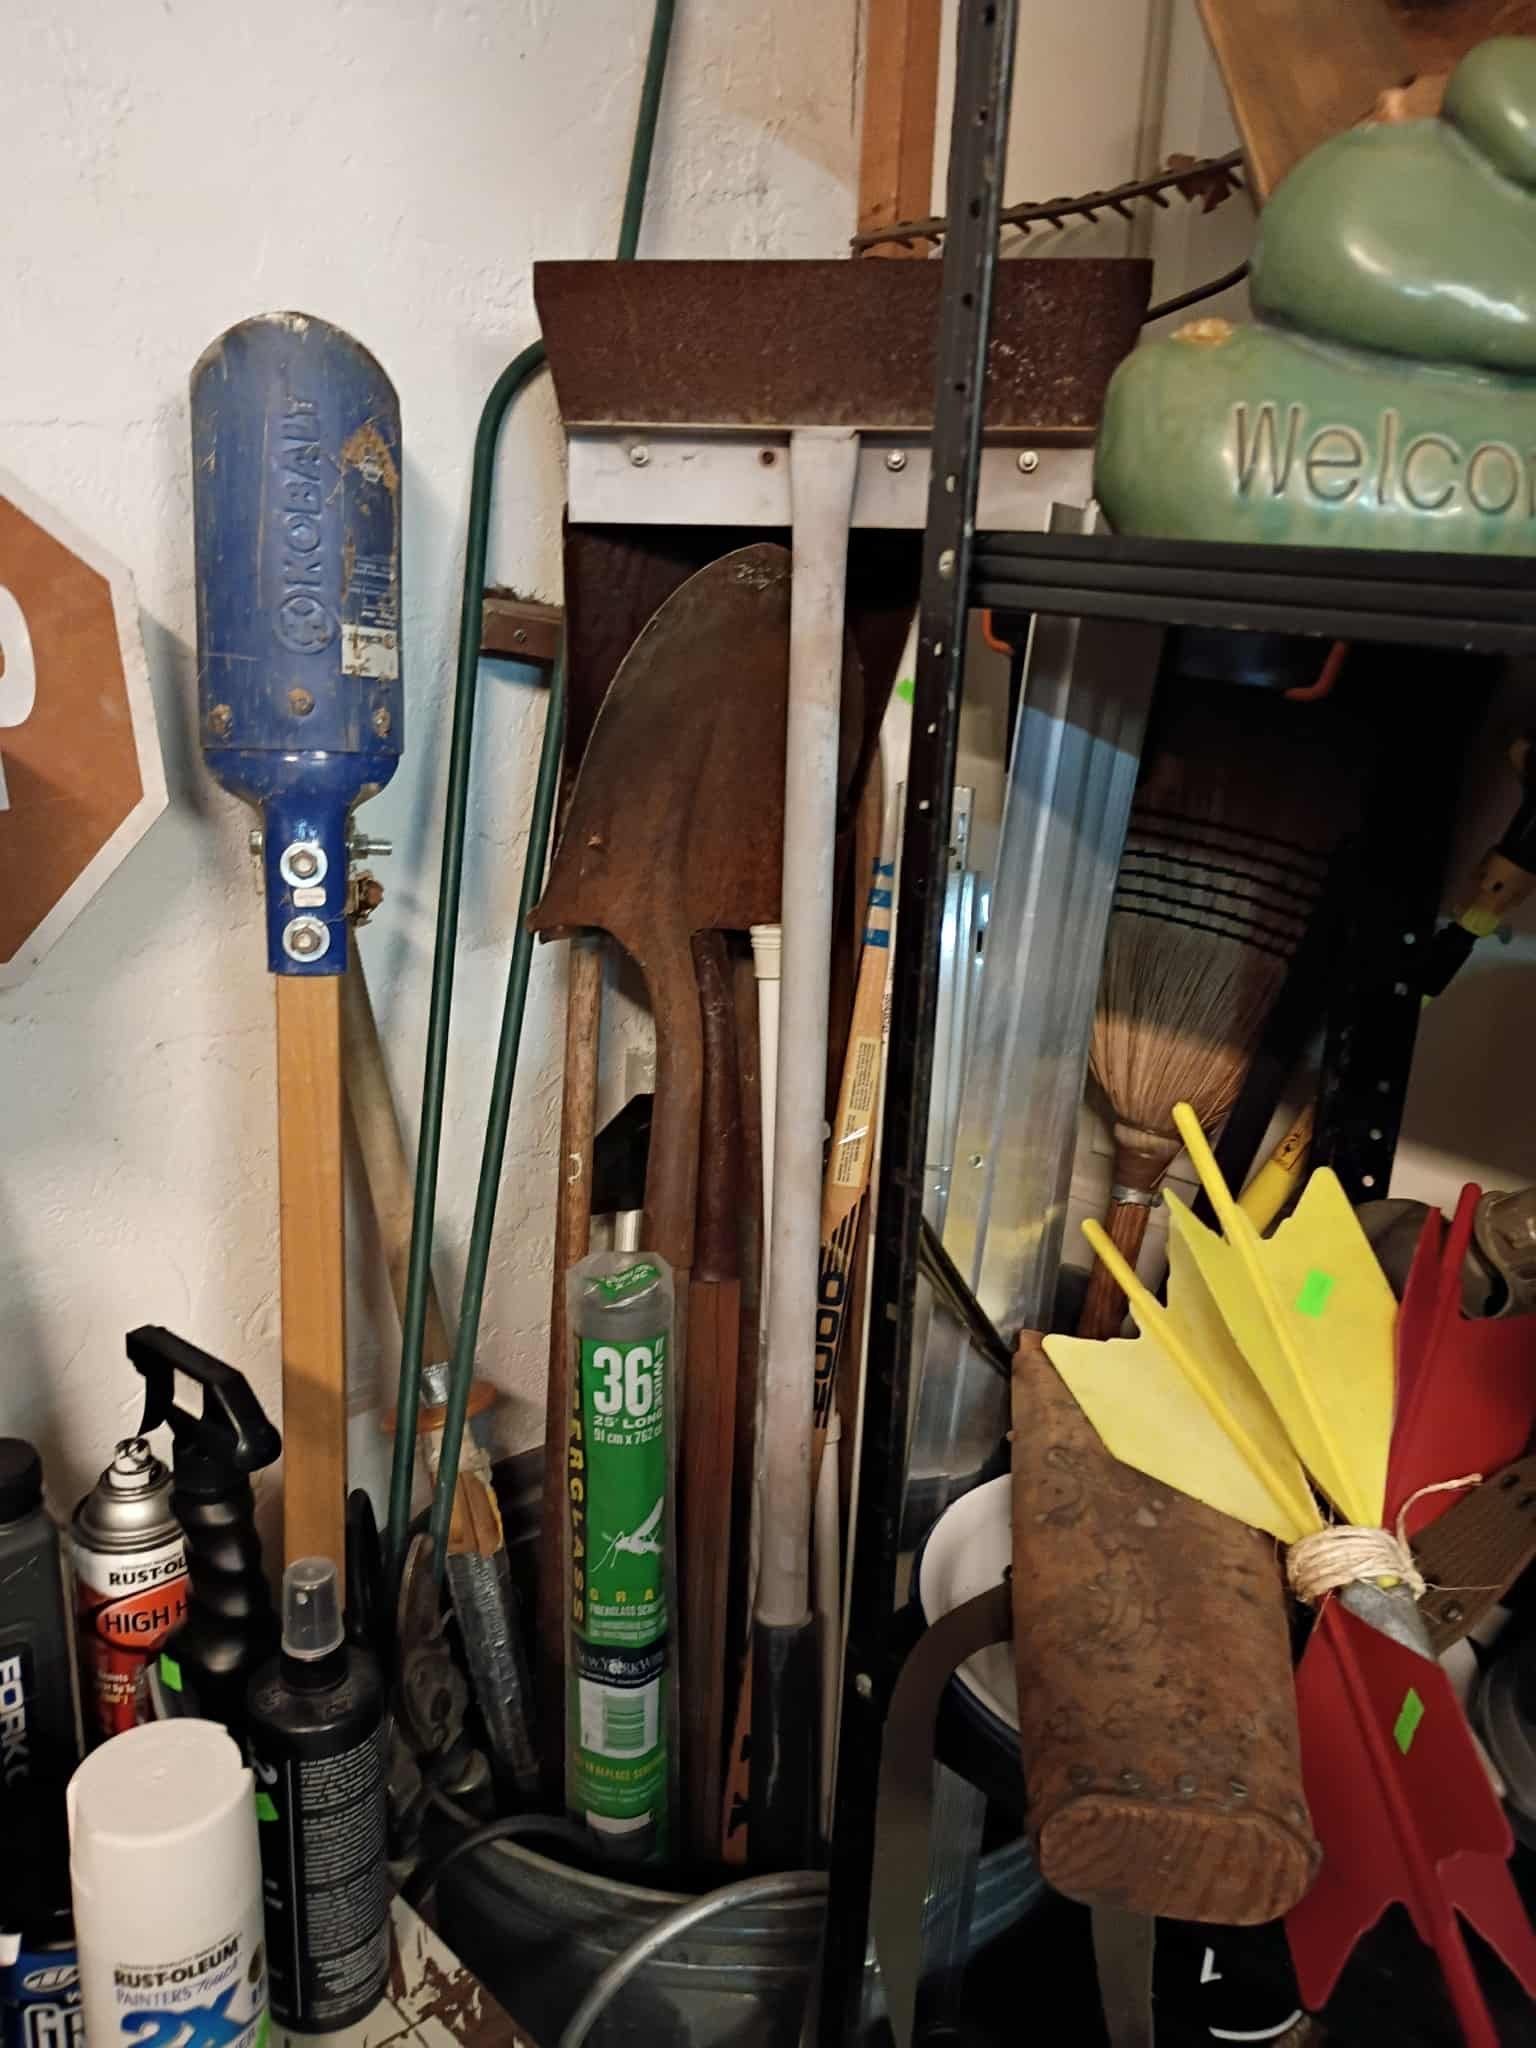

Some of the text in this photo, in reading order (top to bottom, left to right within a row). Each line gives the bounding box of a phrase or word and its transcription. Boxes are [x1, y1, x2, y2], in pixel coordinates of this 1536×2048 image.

[278, 391, 323, 592] KOBALT
[1232, 399, 1536, 520] Welco
[104, 1606, 170, 1634] HIGH
[113, 1937, 240, 1988] RUST-OLEUM
